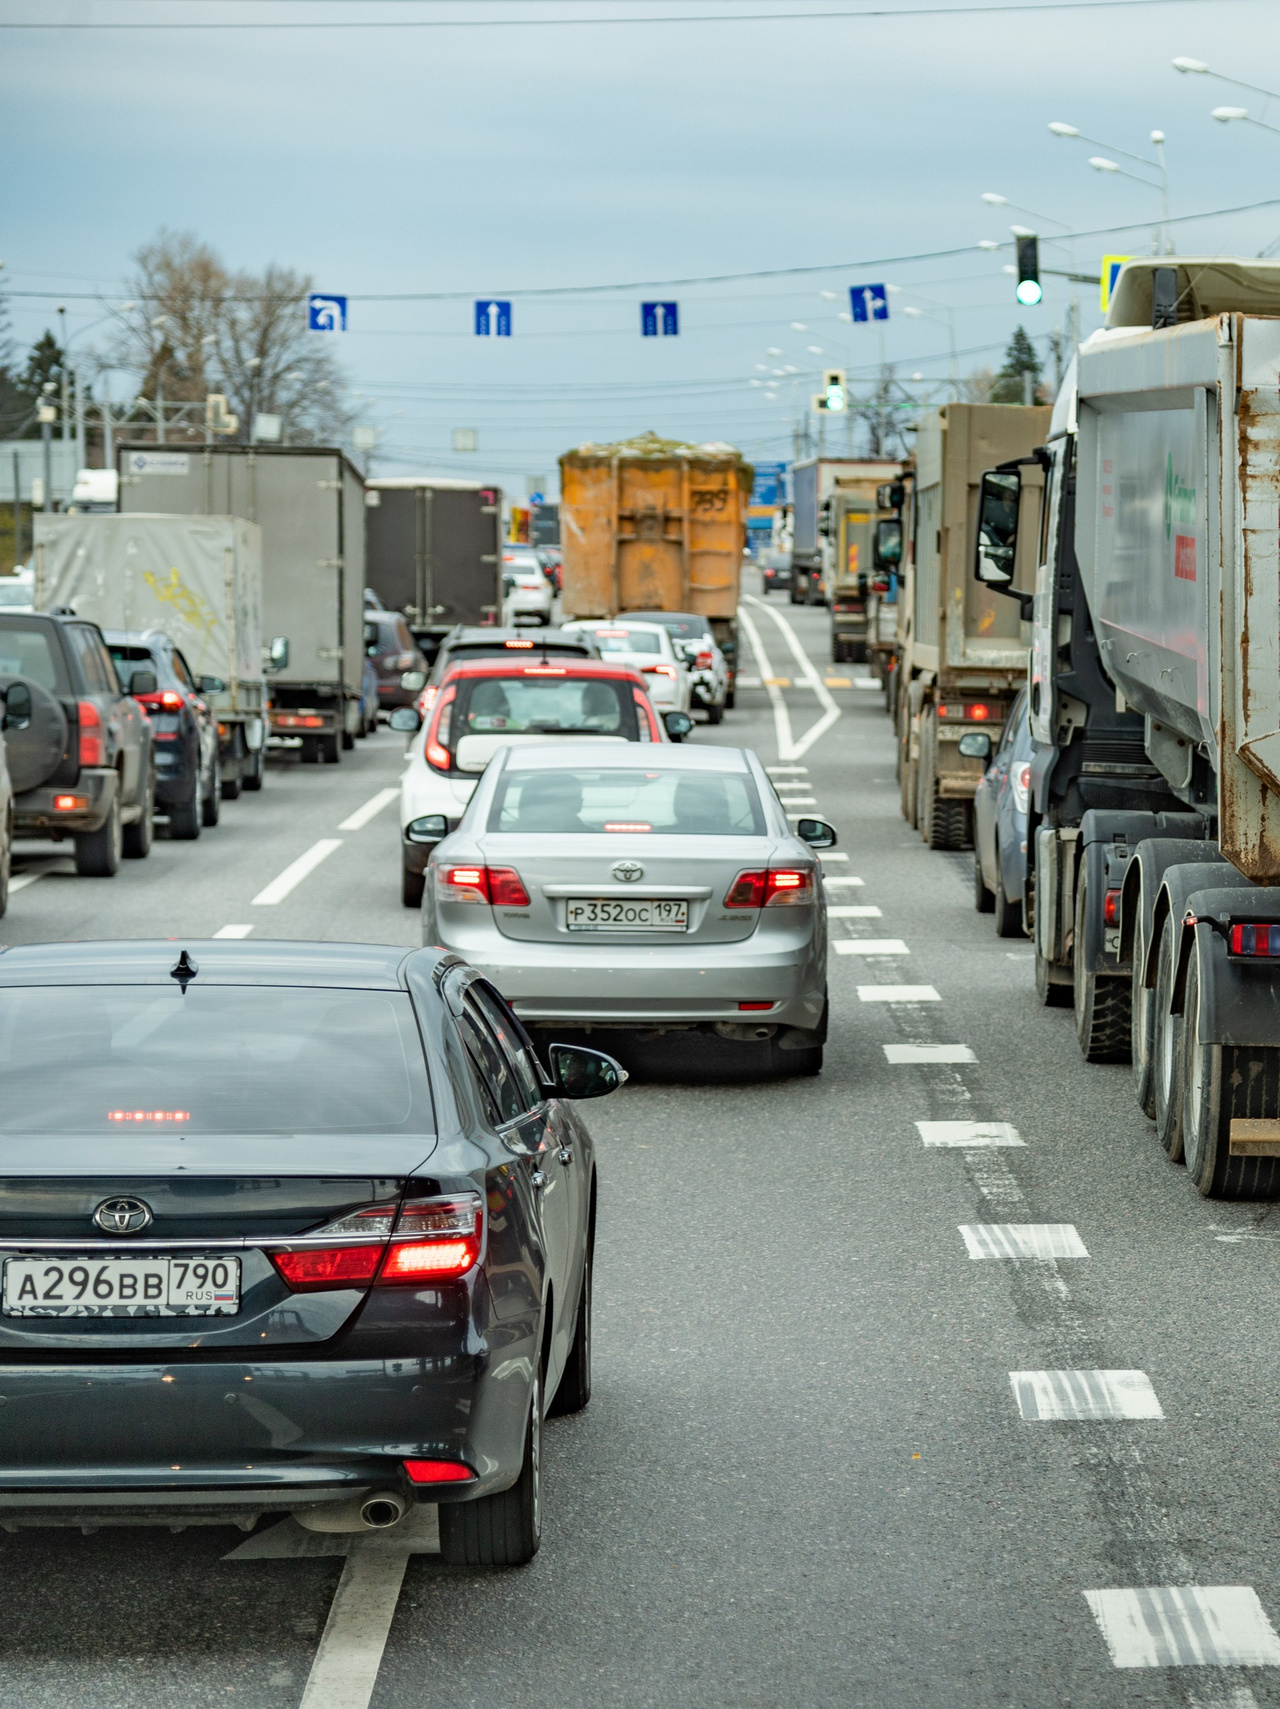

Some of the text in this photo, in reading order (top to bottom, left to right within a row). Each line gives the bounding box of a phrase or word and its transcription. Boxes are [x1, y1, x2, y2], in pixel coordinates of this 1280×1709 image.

[574, 903, 649, 922] Р352ОС
[654, 903, 682, 917] 197
[17, 1265, 163, 1301] А296ВВ
[173, 1262, 229, 1290] 790
[185, 1291, 213, 1301] RUS
